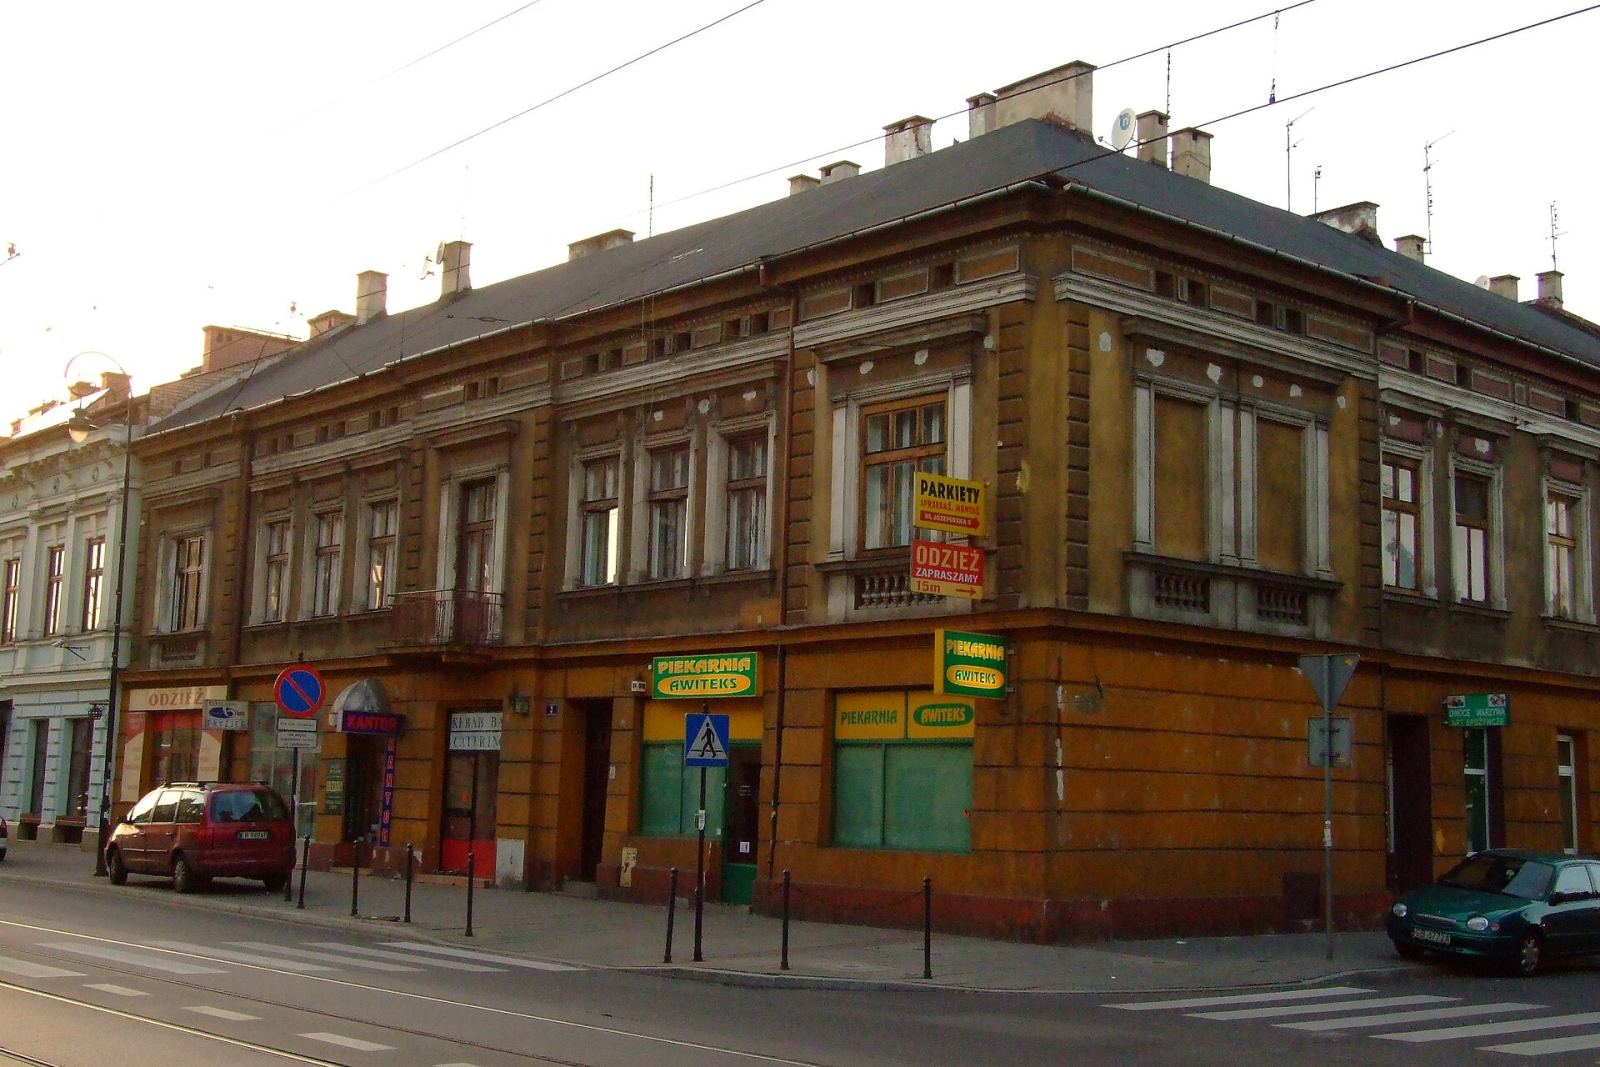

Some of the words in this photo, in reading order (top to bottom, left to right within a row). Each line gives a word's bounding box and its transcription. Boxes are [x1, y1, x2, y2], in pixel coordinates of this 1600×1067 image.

[920, 479, 980, 504] PARKIETY
[916, 545, 980, 572] ODZIEŻ
[915, 567, 978, 584] ZAPRASZAMY
[916, 580, 941, 593] 15m
[946, 639, 1005, 662] PIEKARNIA
[657, 657, 751, 674] PIEKARNIA
[669, 678, 737, 692] AWITEKS
[955, 669, 996, 685] AWITEKS
[148, 688, 205, 706] ODZIEŻ
[347, 714, 398, 732] KANTOR
[452, 716, 484, 729] KEBAB
[841, 710, 897, 725] PIEKARNIA
[921, 707, 966, 723] AWITEKS
[453, 735, 502, 748] CATERIN
